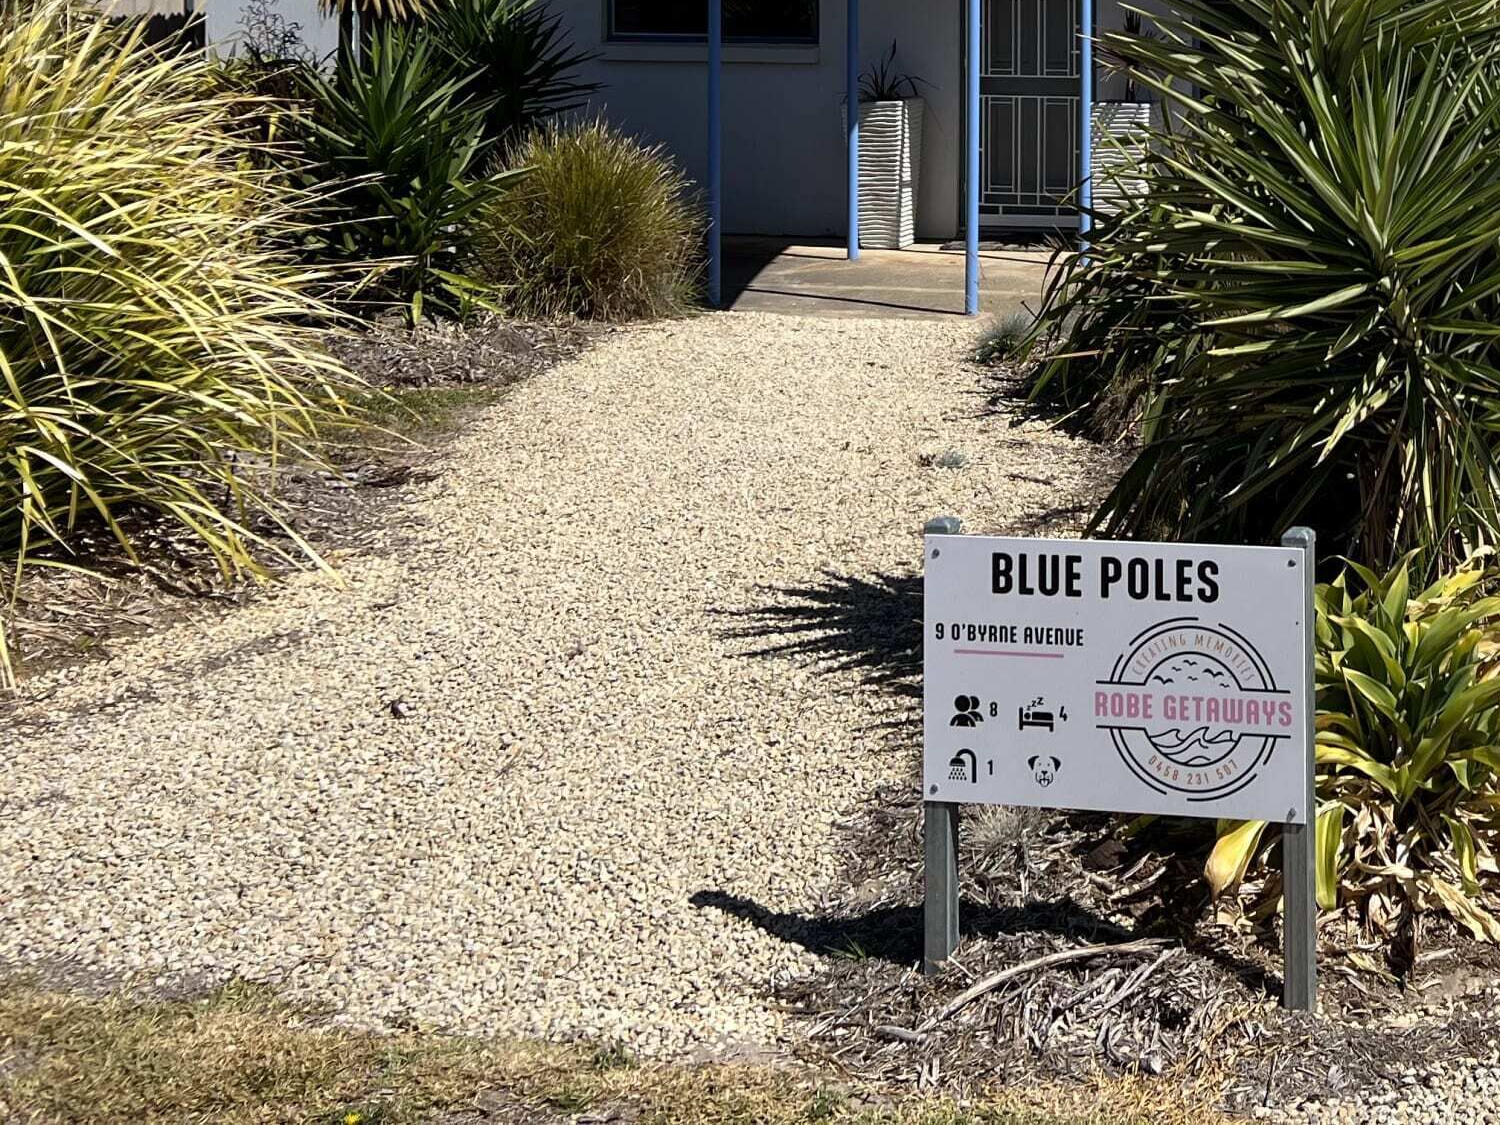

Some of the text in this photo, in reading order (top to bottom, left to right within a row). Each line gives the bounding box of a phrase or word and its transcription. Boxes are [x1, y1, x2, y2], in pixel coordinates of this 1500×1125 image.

[992, 552, 1219, 603] BLUE POLES
[935, 623, 1084, 646] 9 O'BYRNE AVENUE
[1132, 633, 1255, 682] CREATING MEMORIES
[989, 701, 998, 717] 8
[1059, 705, 1068, 722] 4
[1095, 691, 1292, 727] ROBE GETAWAYS
[987, 759, 994, 776] 1
[1148, 754, 1179, 781] 0458
